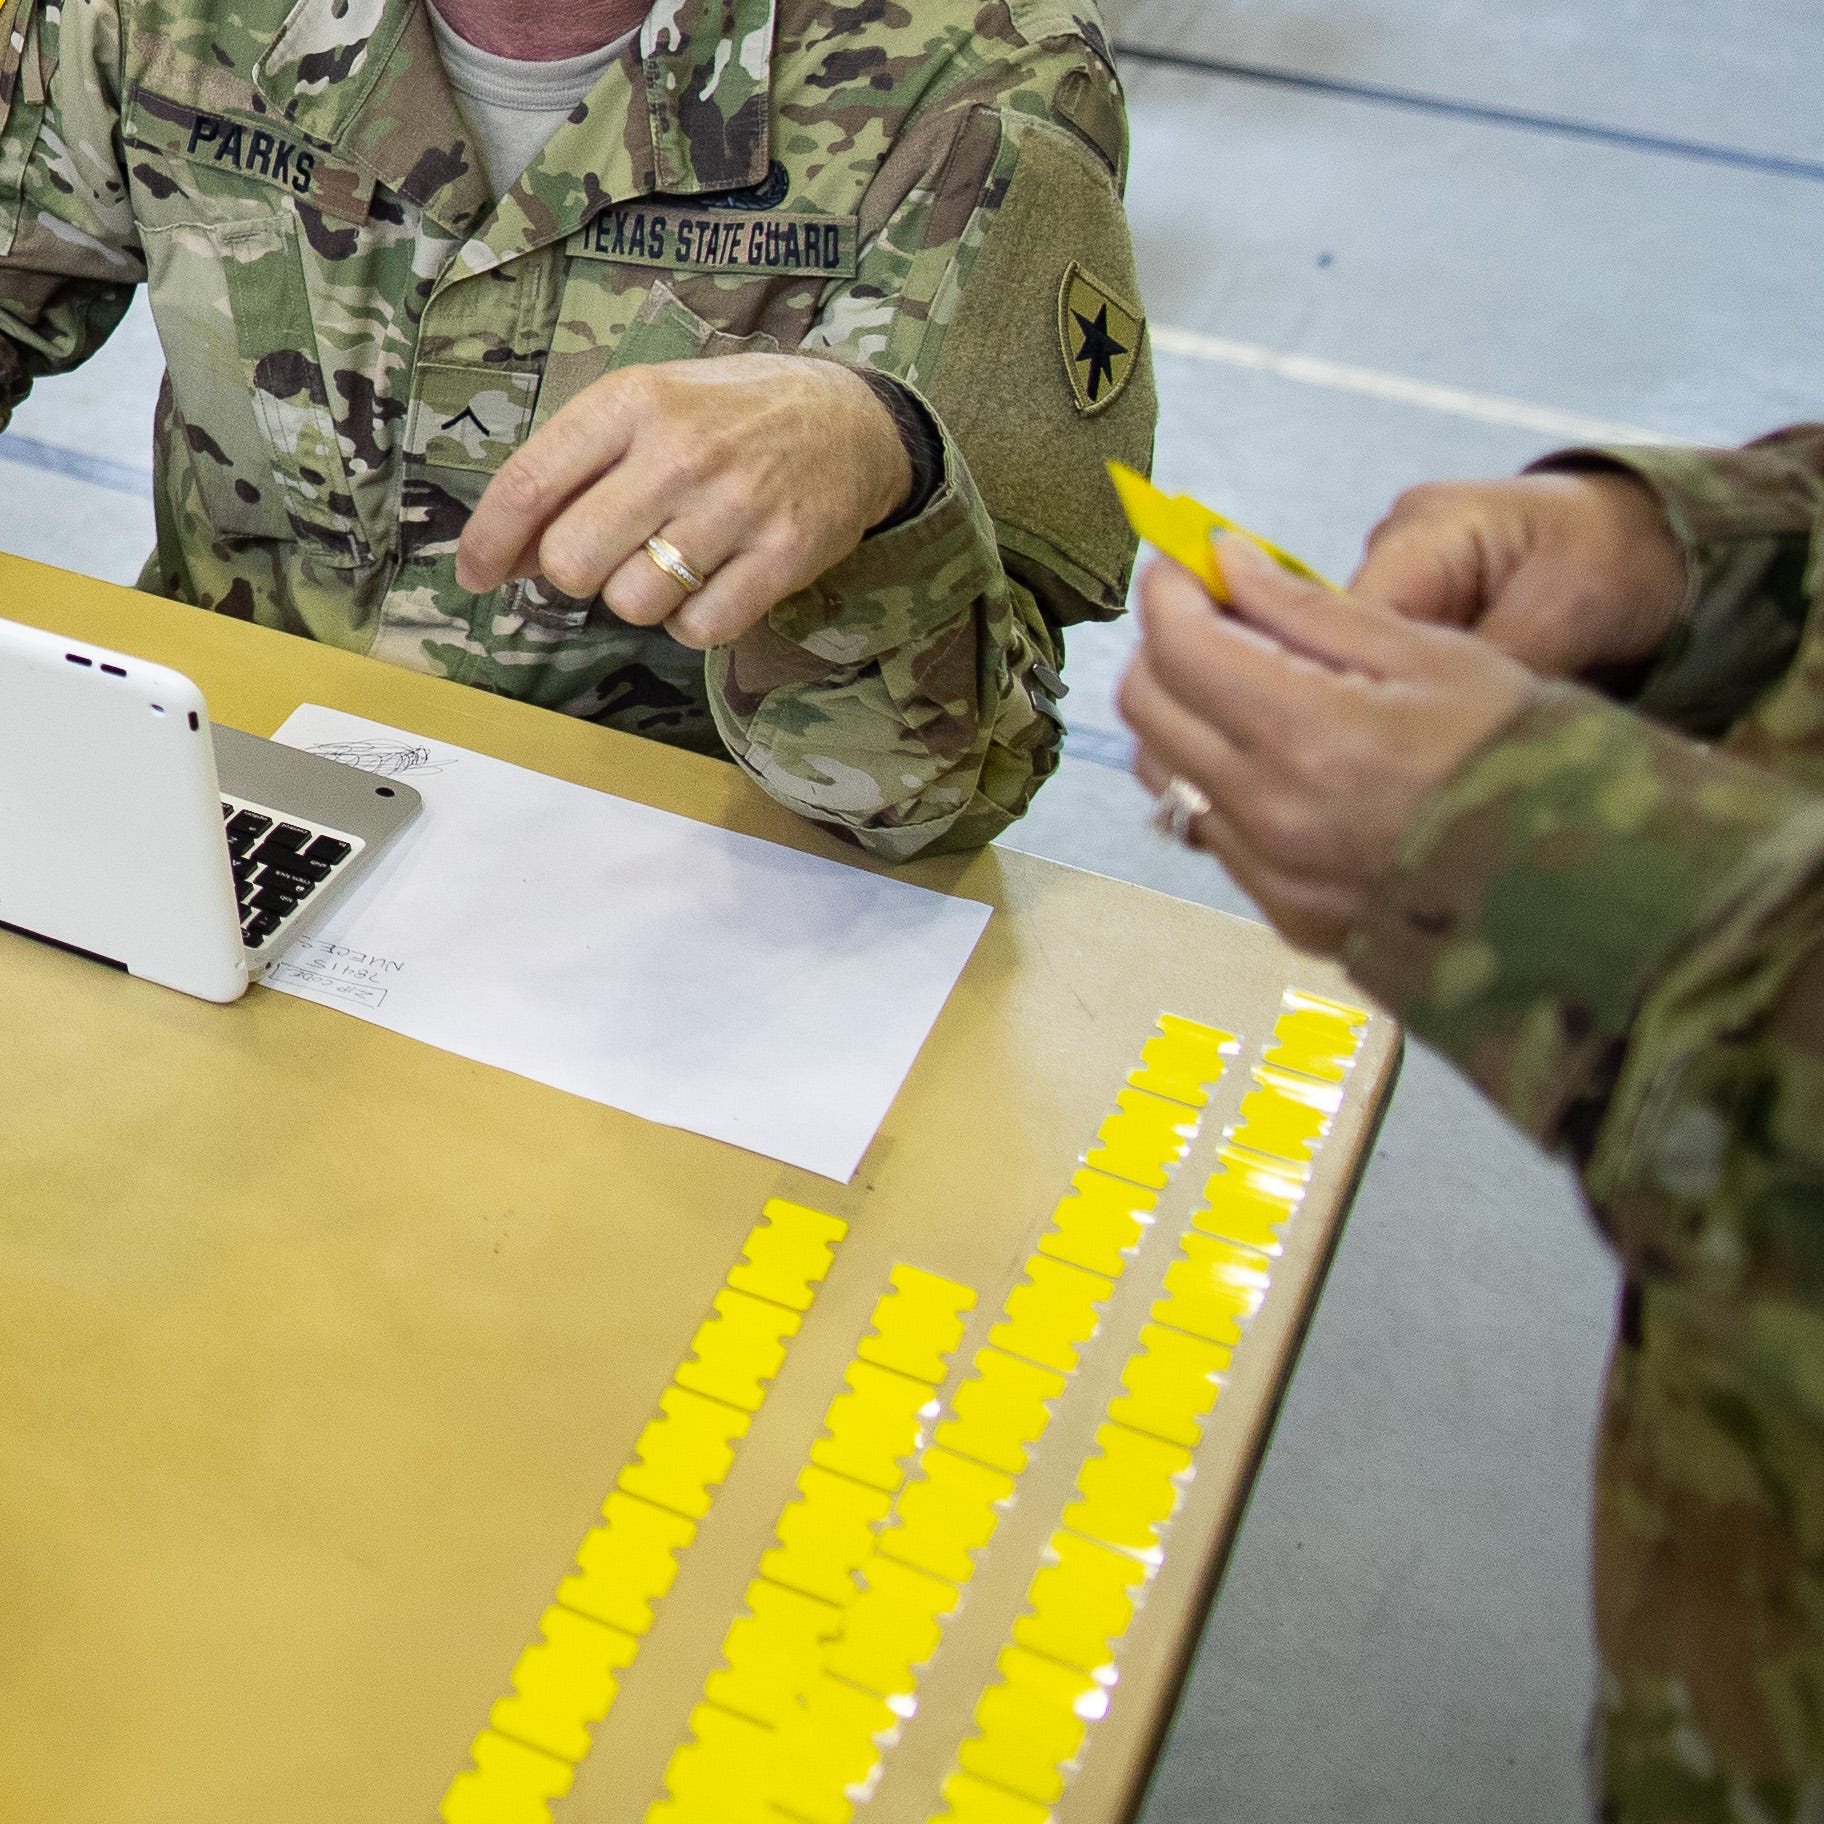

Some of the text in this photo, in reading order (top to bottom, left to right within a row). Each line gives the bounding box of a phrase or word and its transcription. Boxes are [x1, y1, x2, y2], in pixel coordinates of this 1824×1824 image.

[186, 114, 316, 194] PARKS
[581, 207, 841, 269] TEXAS STATE GUARD
